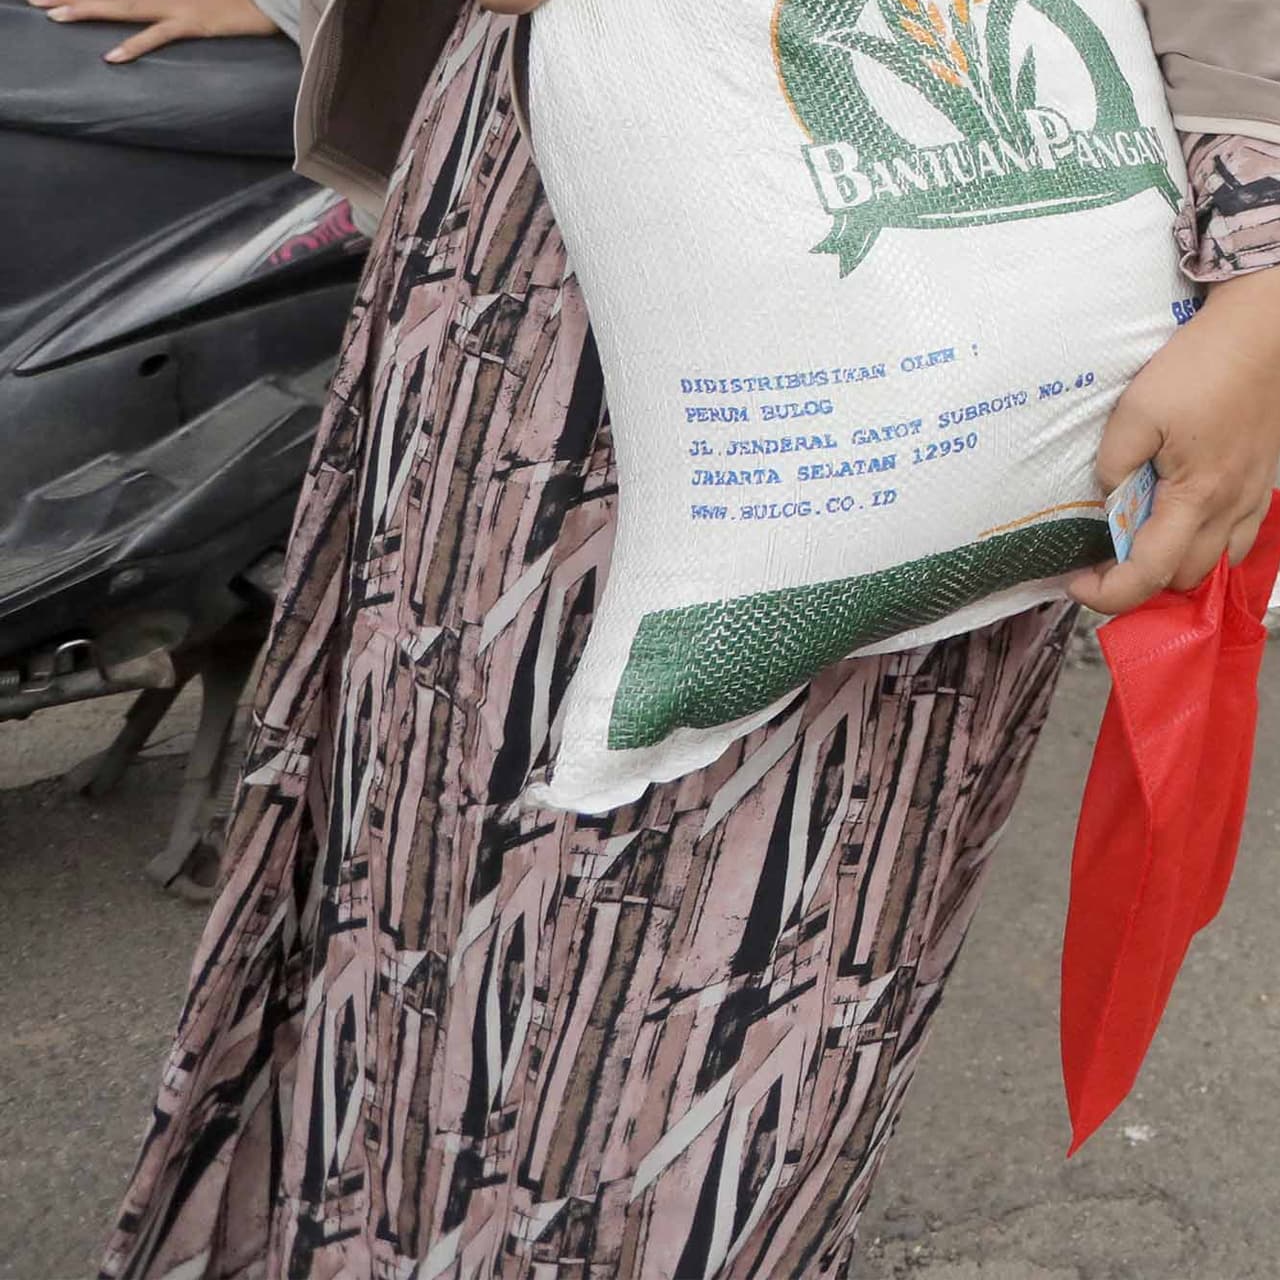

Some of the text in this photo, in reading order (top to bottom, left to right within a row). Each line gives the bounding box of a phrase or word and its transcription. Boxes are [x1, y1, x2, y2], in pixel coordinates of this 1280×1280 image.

[808, 105, 1169, 210] BANTUAN PANGAN
[680, 363, 886, 394] DIDISTRIBUSIKAN
[900, 347, 957, 373] OLEH
[685, 399, 834, 423] PERUM BULOG
[852, 418, 923, 446] GATOT
[938, 390, 1028, 430] SUBROTO
[692, 431, 979, 487] JAKARTA SELATAN 12950
